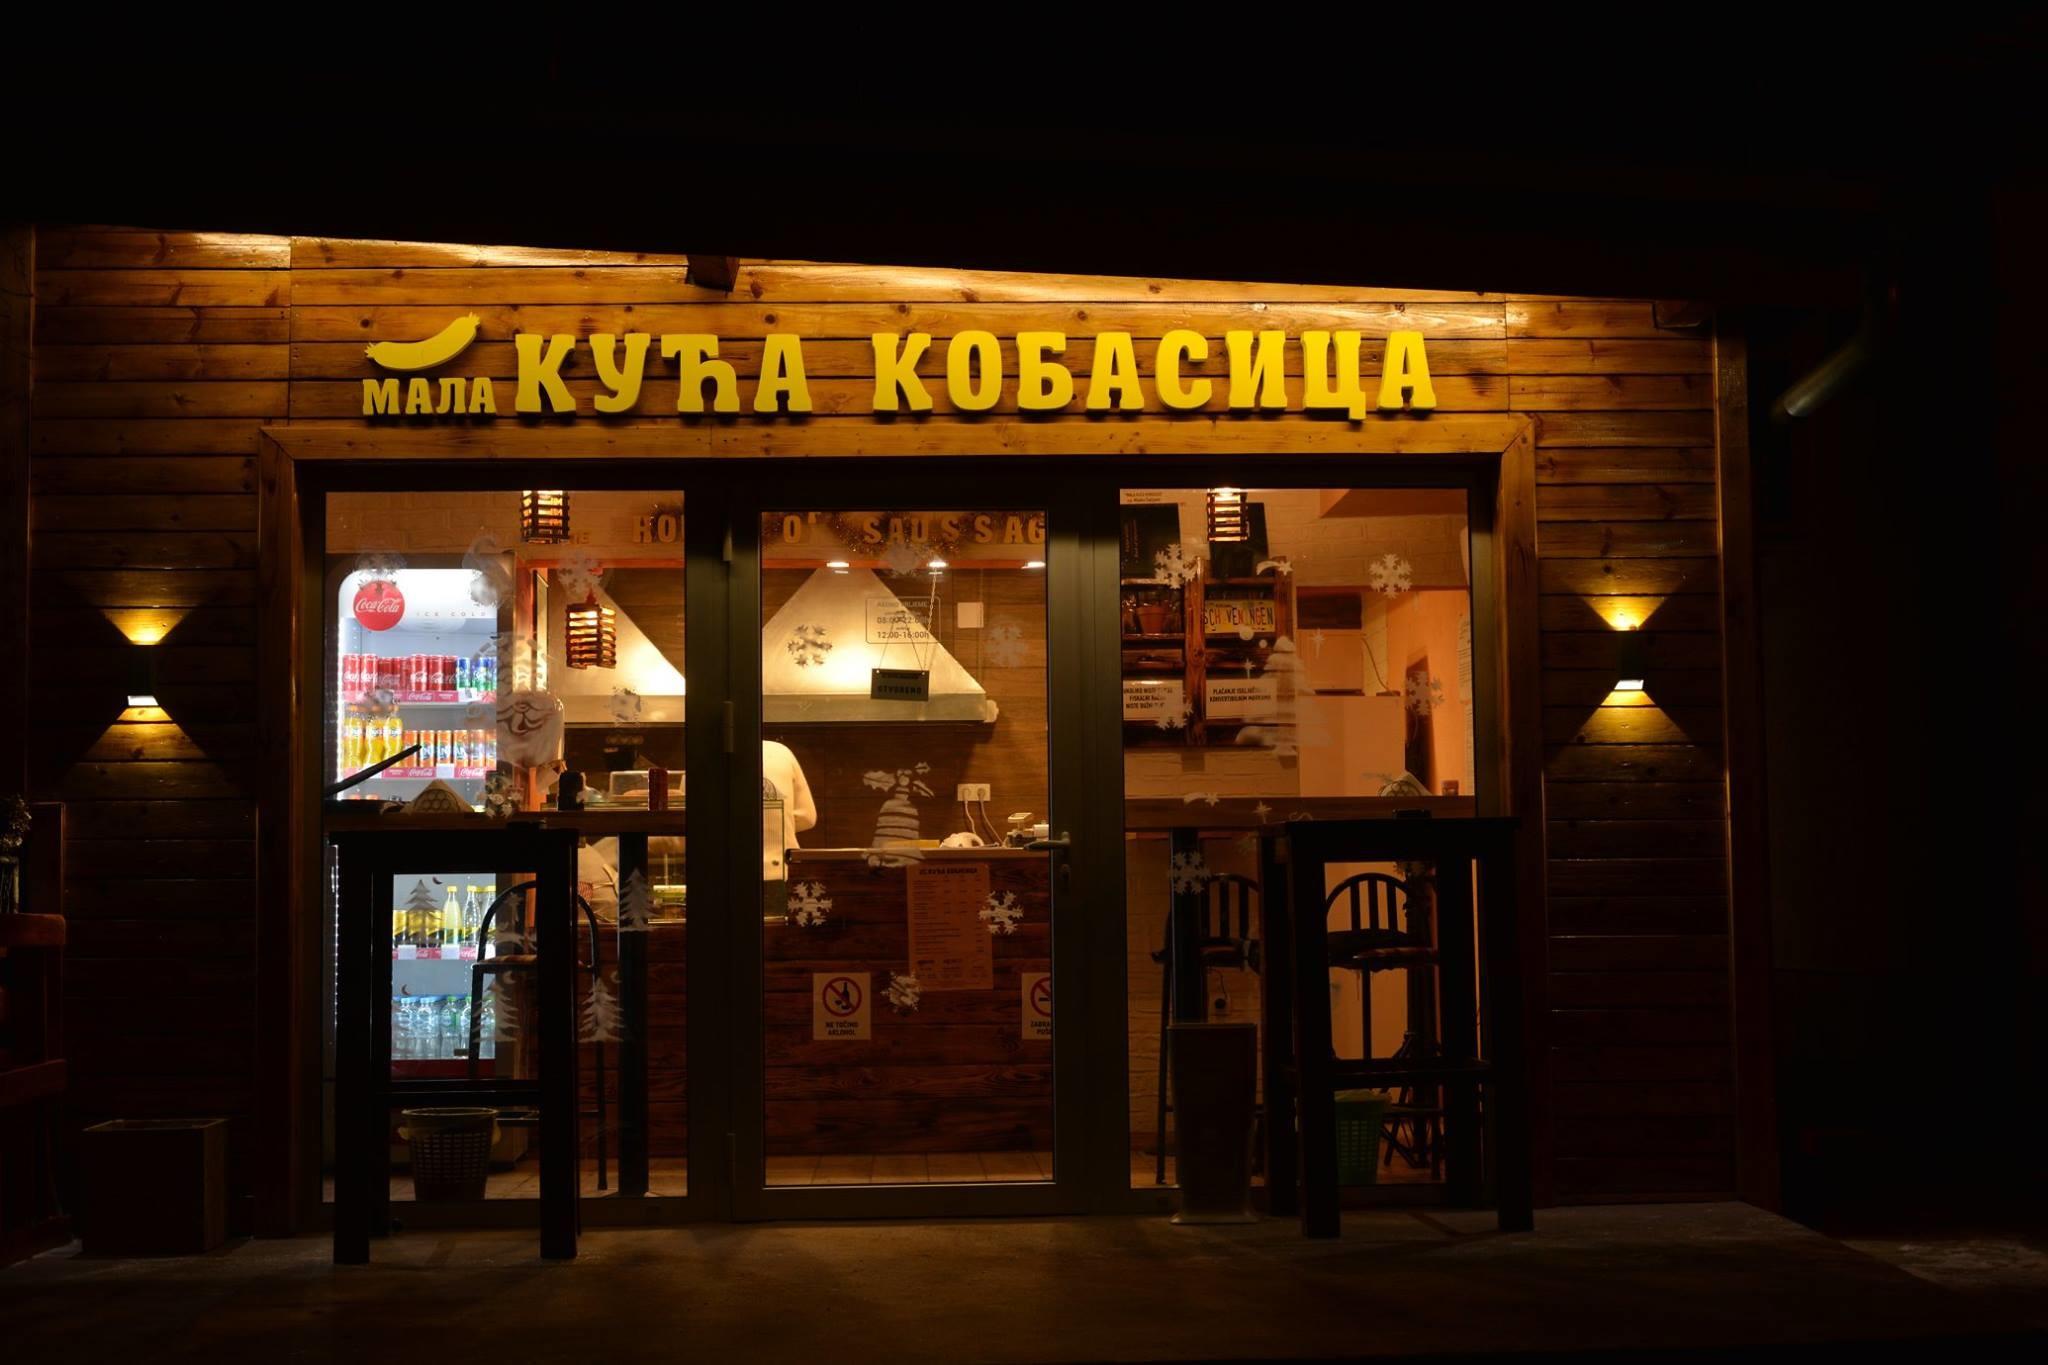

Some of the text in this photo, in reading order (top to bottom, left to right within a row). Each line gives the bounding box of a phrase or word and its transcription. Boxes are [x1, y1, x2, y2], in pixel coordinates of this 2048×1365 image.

[362, 330, 1437, 420] МАЛА КУЋА КОБАСИЦА
[355, 597, 402, 613] Coca-Cola
